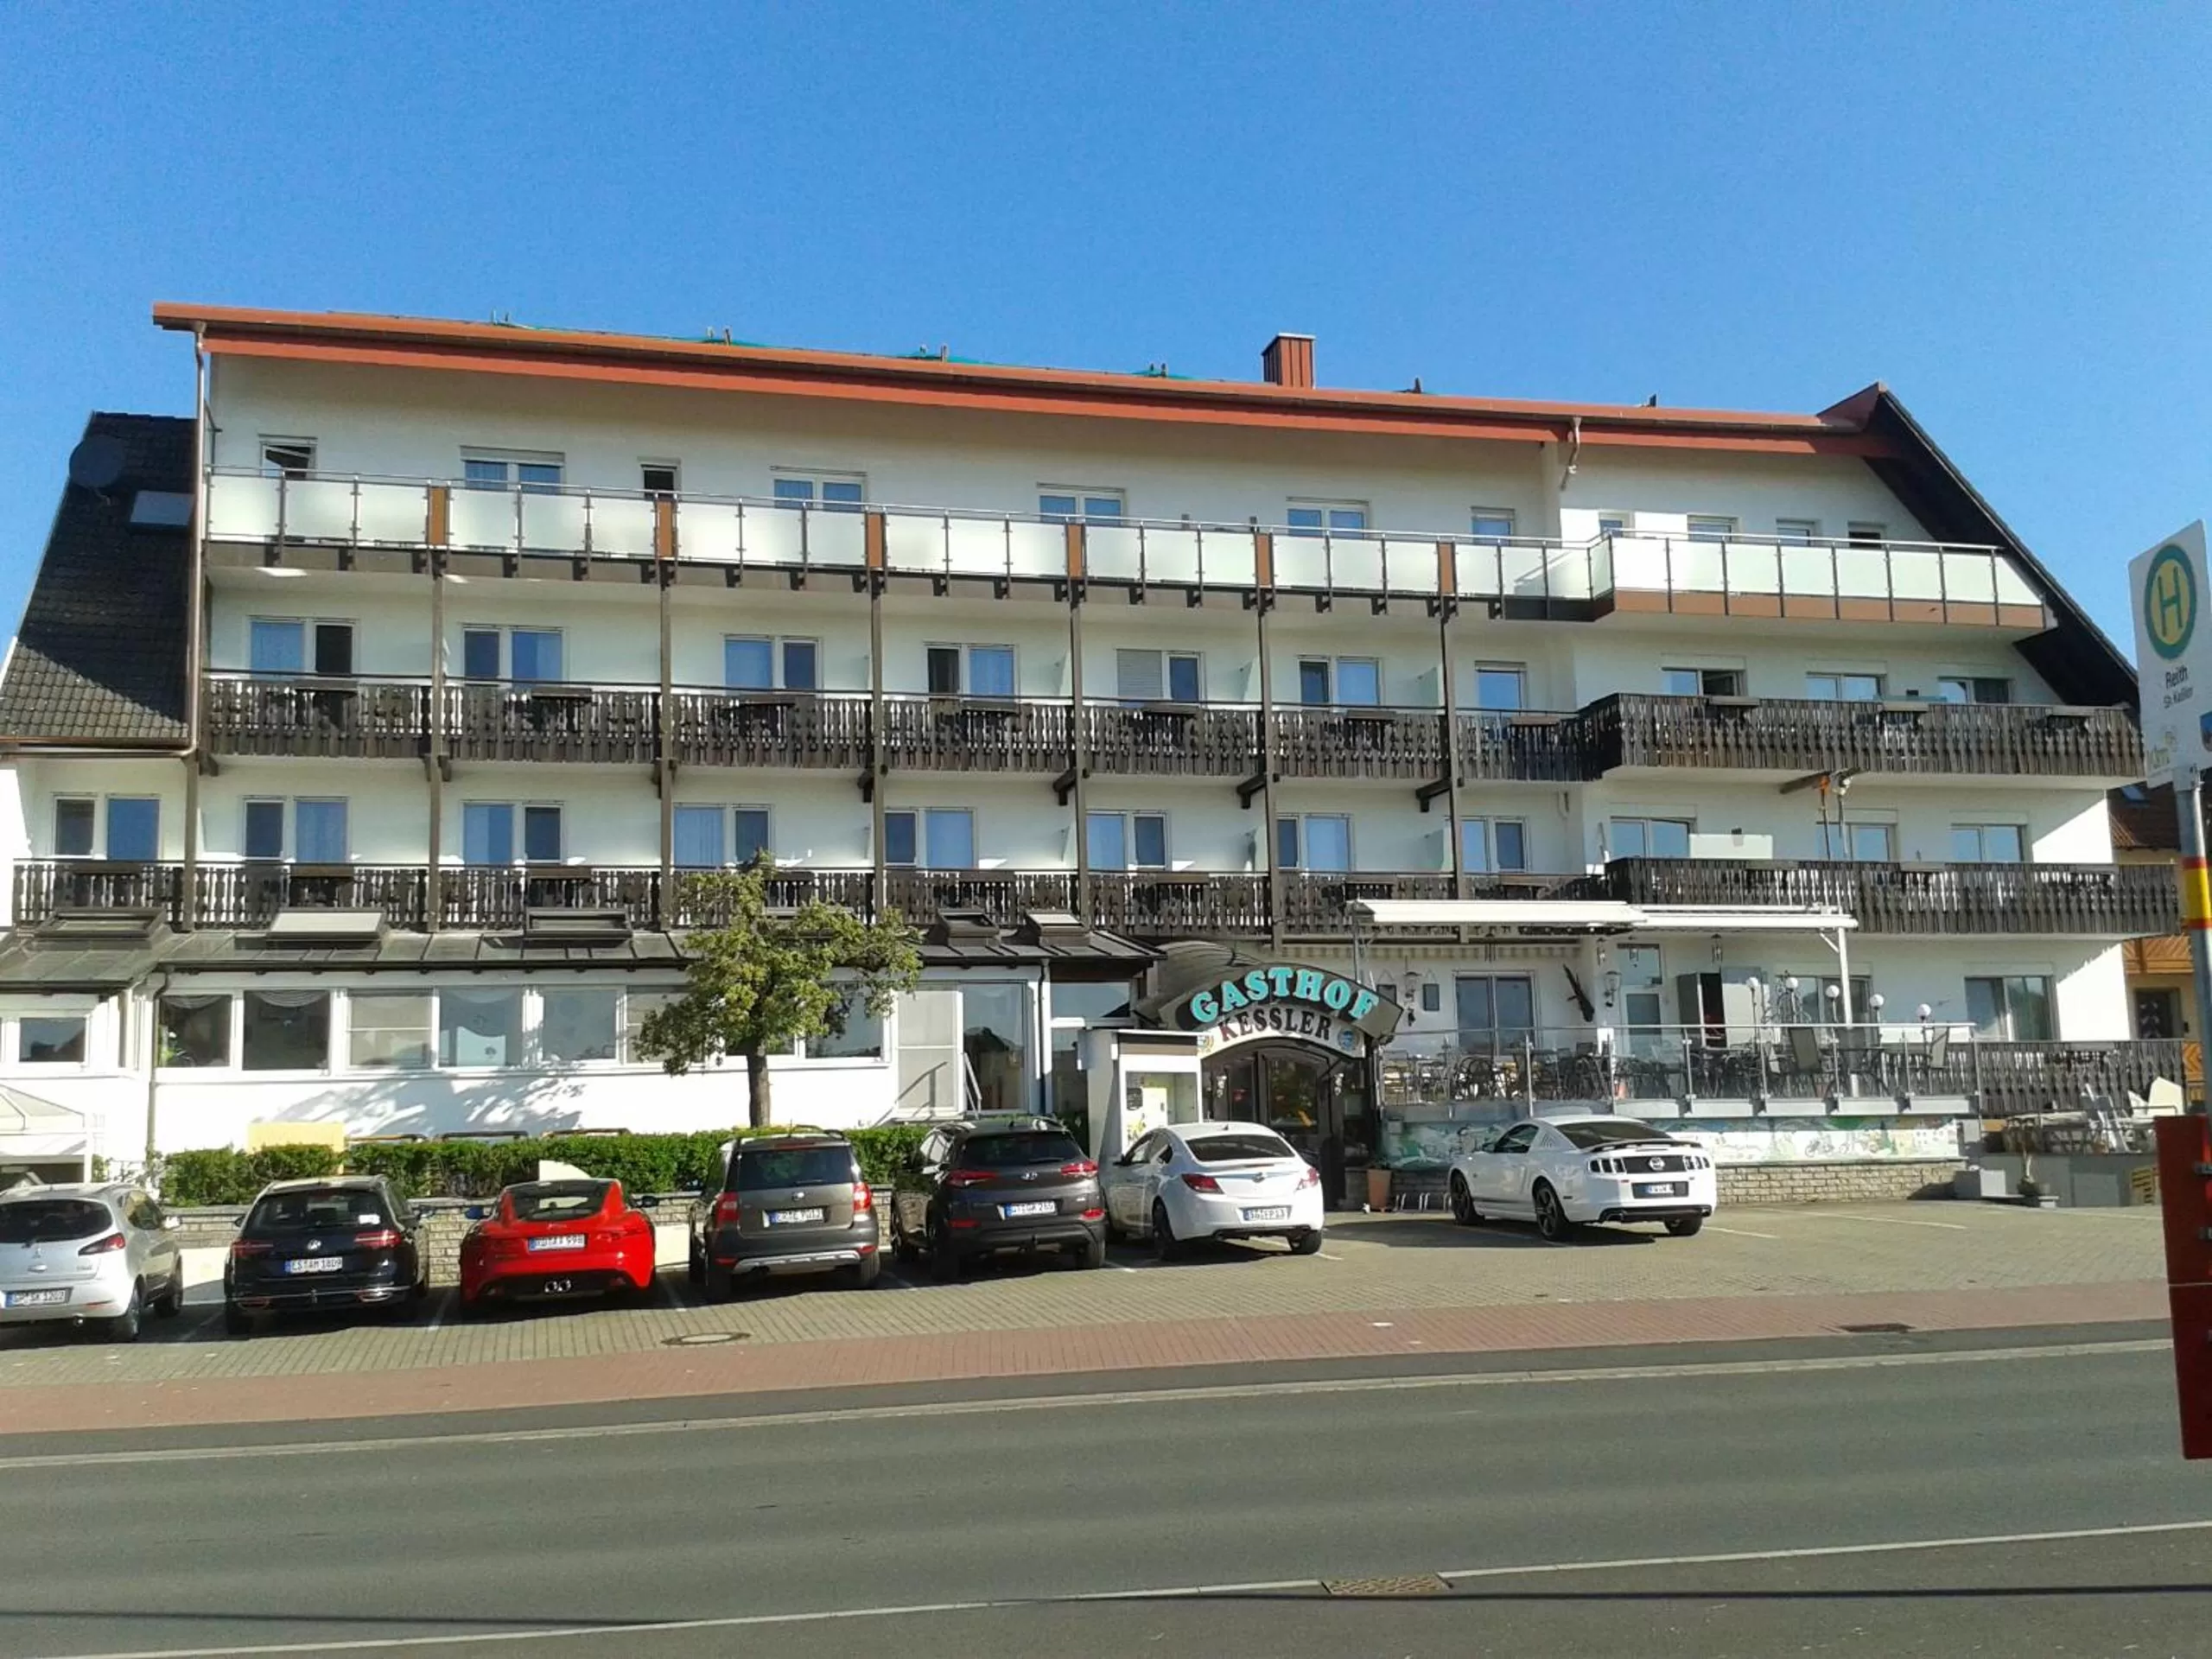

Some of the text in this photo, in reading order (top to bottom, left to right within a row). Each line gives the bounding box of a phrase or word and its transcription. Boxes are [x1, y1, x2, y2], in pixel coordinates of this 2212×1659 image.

[2157, 564, 2183, 638] H
[1190, 967, 1379, 1023] GASTHOF
[1218, 1007, 1332, 1042] KESSLER
